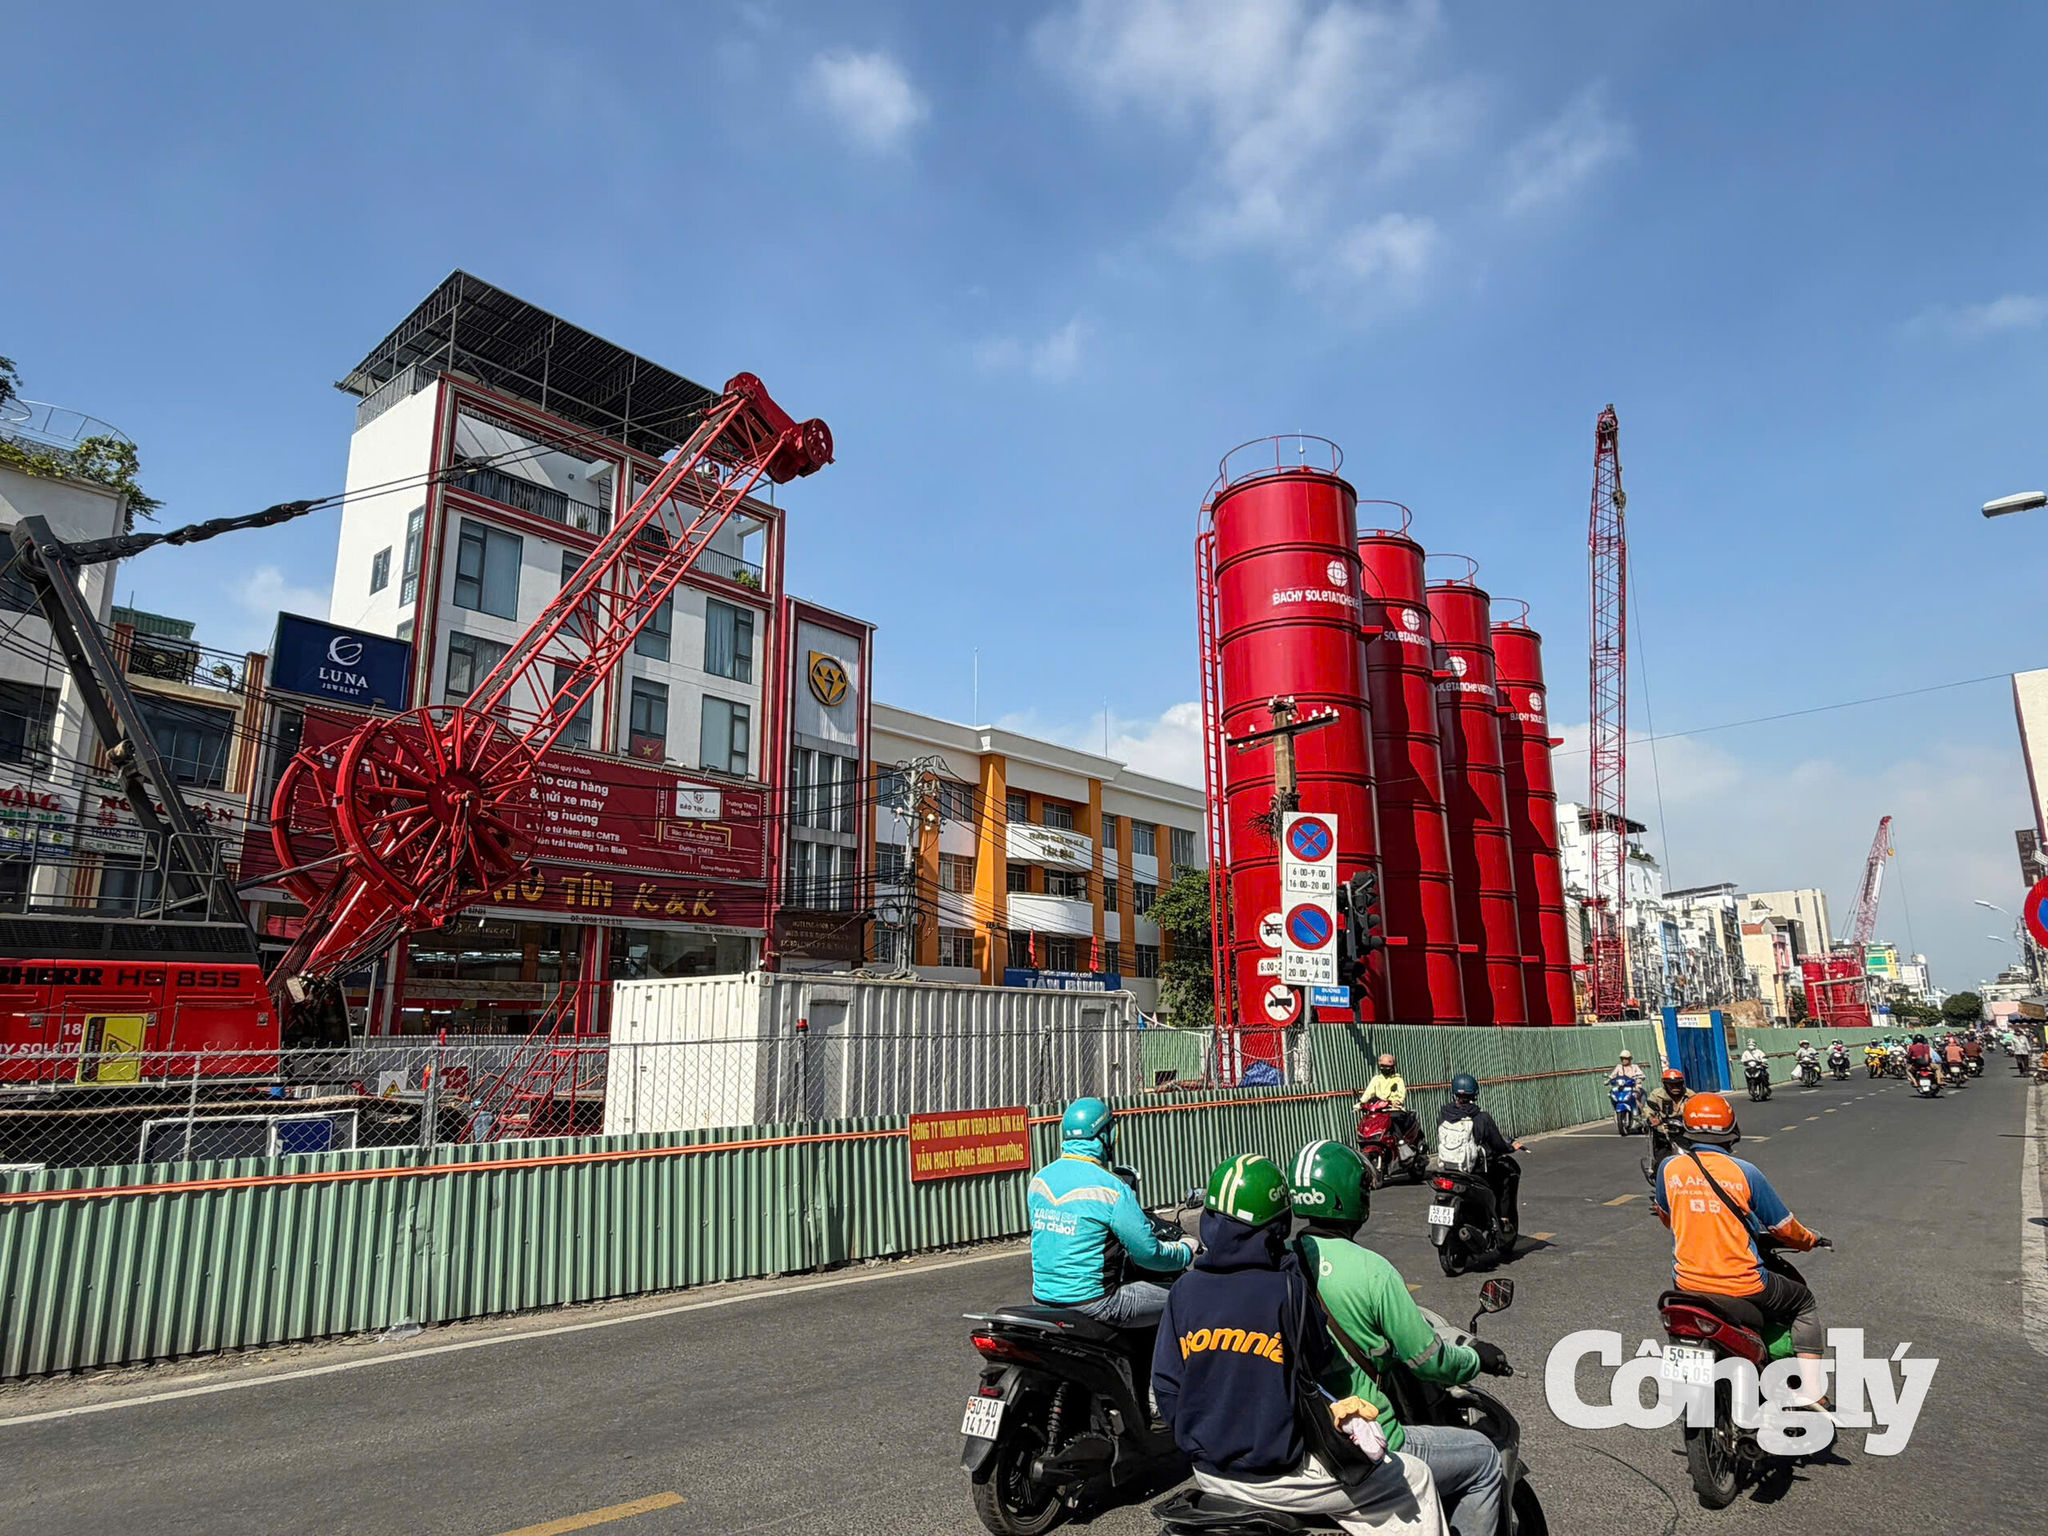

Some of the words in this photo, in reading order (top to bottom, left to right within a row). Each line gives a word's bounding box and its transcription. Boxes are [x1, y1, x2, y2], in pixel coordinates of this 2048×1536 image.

[1272, 588, 1302, 605] BACHY
[319, 667, 368, 688] LUNA
[322, 682, 360, 696] JEWELRY
[573, 767, 592, 775] khách
[556, 776, 578, 790] cửa
[580, 781, 609, 796] hàng
[529, 787, 539, 799] &
[563, 795, 577, 805] xe
[580, 798, 605, 812] máy
[567, 840, 594, 852] trường
[561, 872, 613, 907] TÍN
[117, 969, 165, 986] HS
[176, 970, 240, 988] 855
[911, 1119, 930, 1140] CÔNG
[931, 1121, 938, 1138] TY
[940, 1120, 956, 1138] TNHH
[933, 1150, 953, 1173] HOẠT
[954, 1145, 976, 1171] ĐỘNG
[977, 1143, 995, 1165] BÌNH
[995, 1140, 1025, 1162] THƯỜNG
[964, 1416, 997, 1437] 141.71
